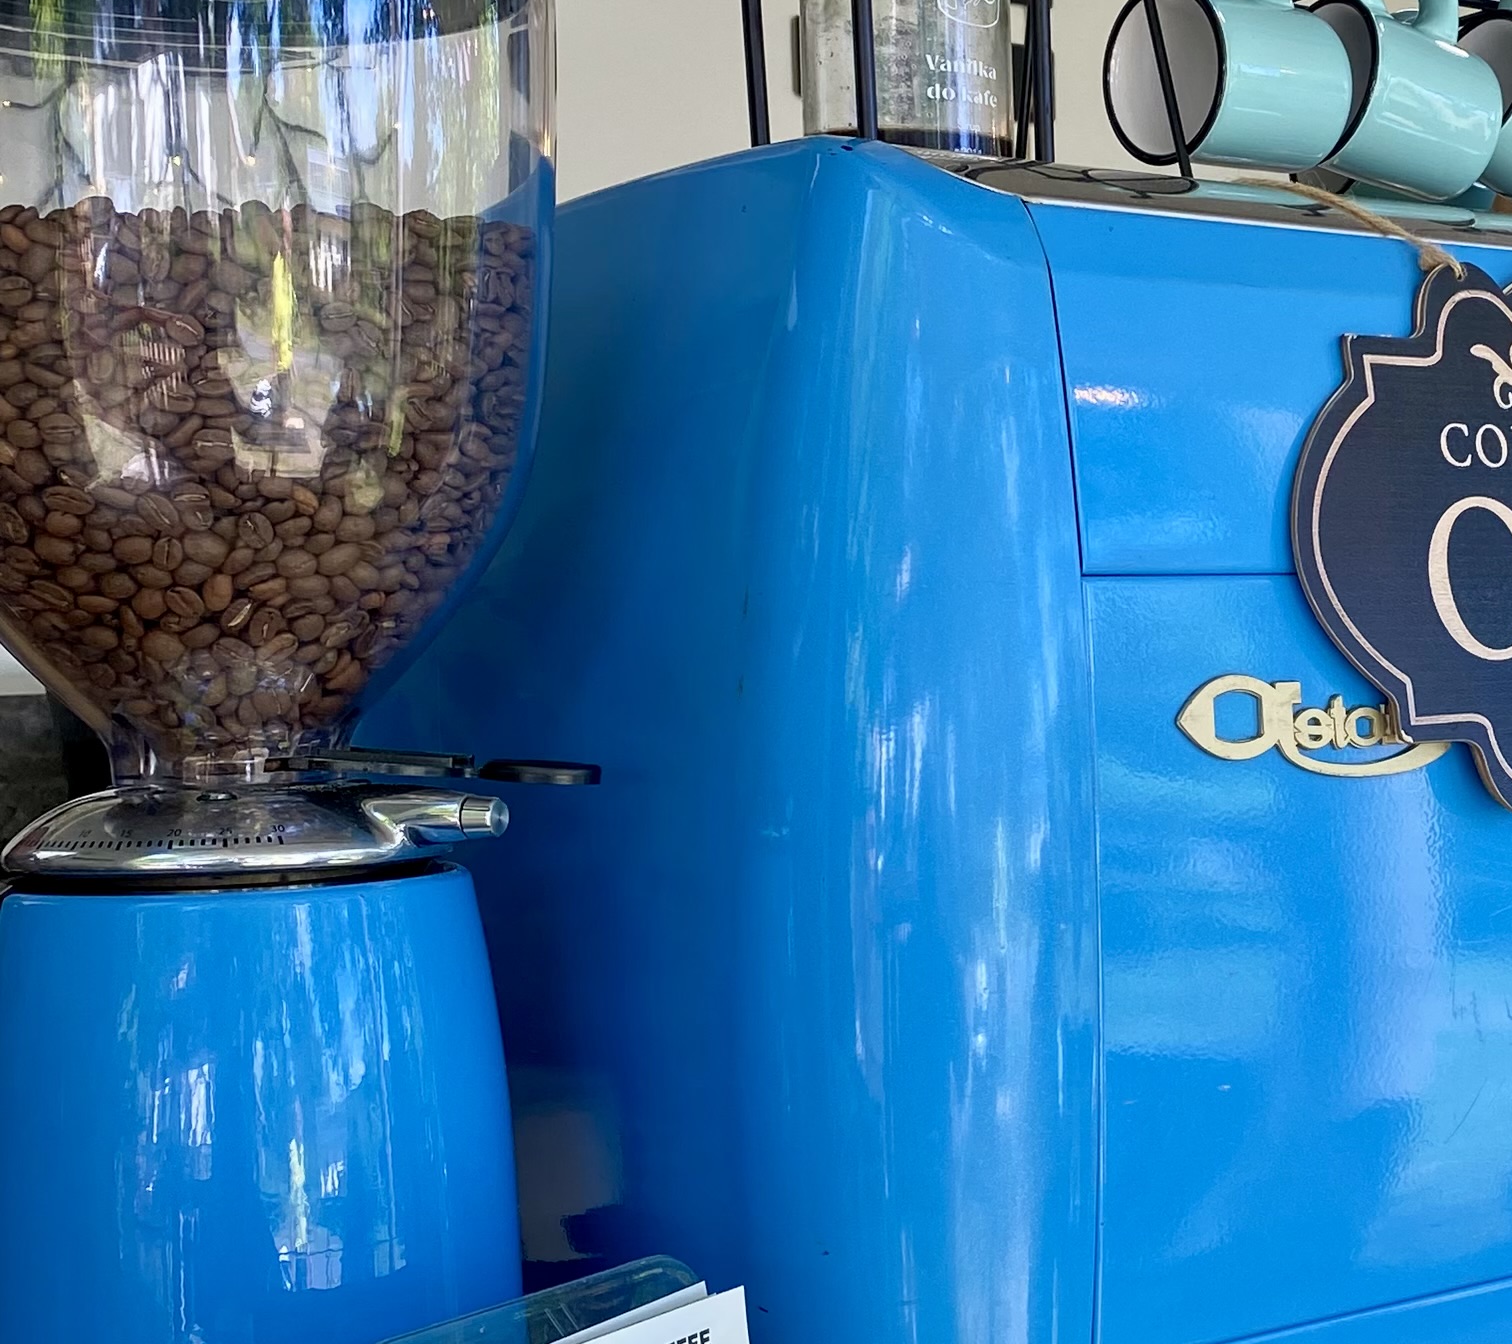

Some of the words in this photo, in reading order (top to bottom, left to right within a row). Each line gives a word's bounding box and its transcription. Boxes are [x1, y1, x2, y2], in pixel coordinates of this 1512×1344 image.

[925, 54, 997, 80] Vanilka
[926, 83, 956, 100] do
[962, 87, 998, 108] kafe
[167, 828, 182, 837] 20
[271, 824, 286, 833] 30
